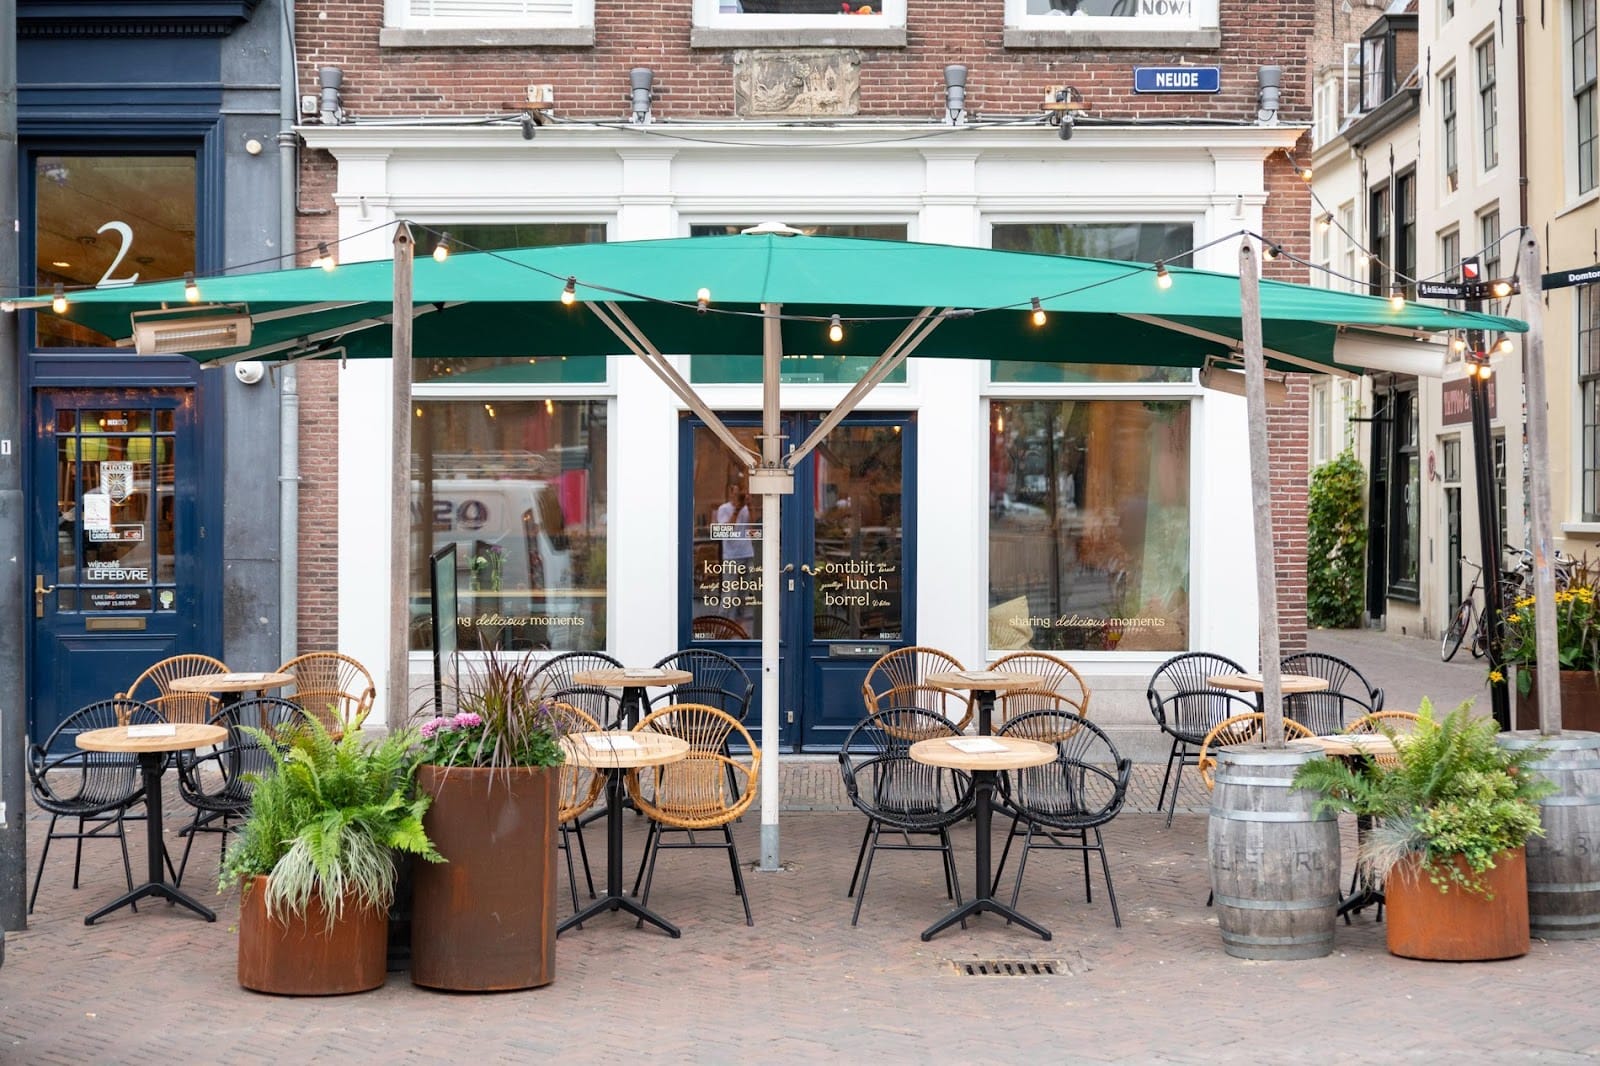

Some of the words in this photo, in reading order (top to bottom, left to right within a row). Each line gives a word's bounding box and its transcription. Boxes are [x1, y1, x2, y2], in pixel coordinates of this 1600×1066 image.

[1156, 72, 1199, 87] NEUDE
[95, 220, 140, 289] 2
[87, 568, 149, 581] LEFEBVRE
[703, 559, 747, 575] koffie
[825, 559, 876, 576] ontbijt
[846, 575, 888, 590] lunch
[703, 595, 720, 606] to
[722, 595, 742, 609] go
[825, 591, 870, 606] borrel
[475, 613, 527, 626] delicious
[530, 615, 585, 626] moments
[1009, 615, 1051, 628] sharing
[1055, 614, 1106, 627] delicious
[1110, 616, 1166, 627] moments
